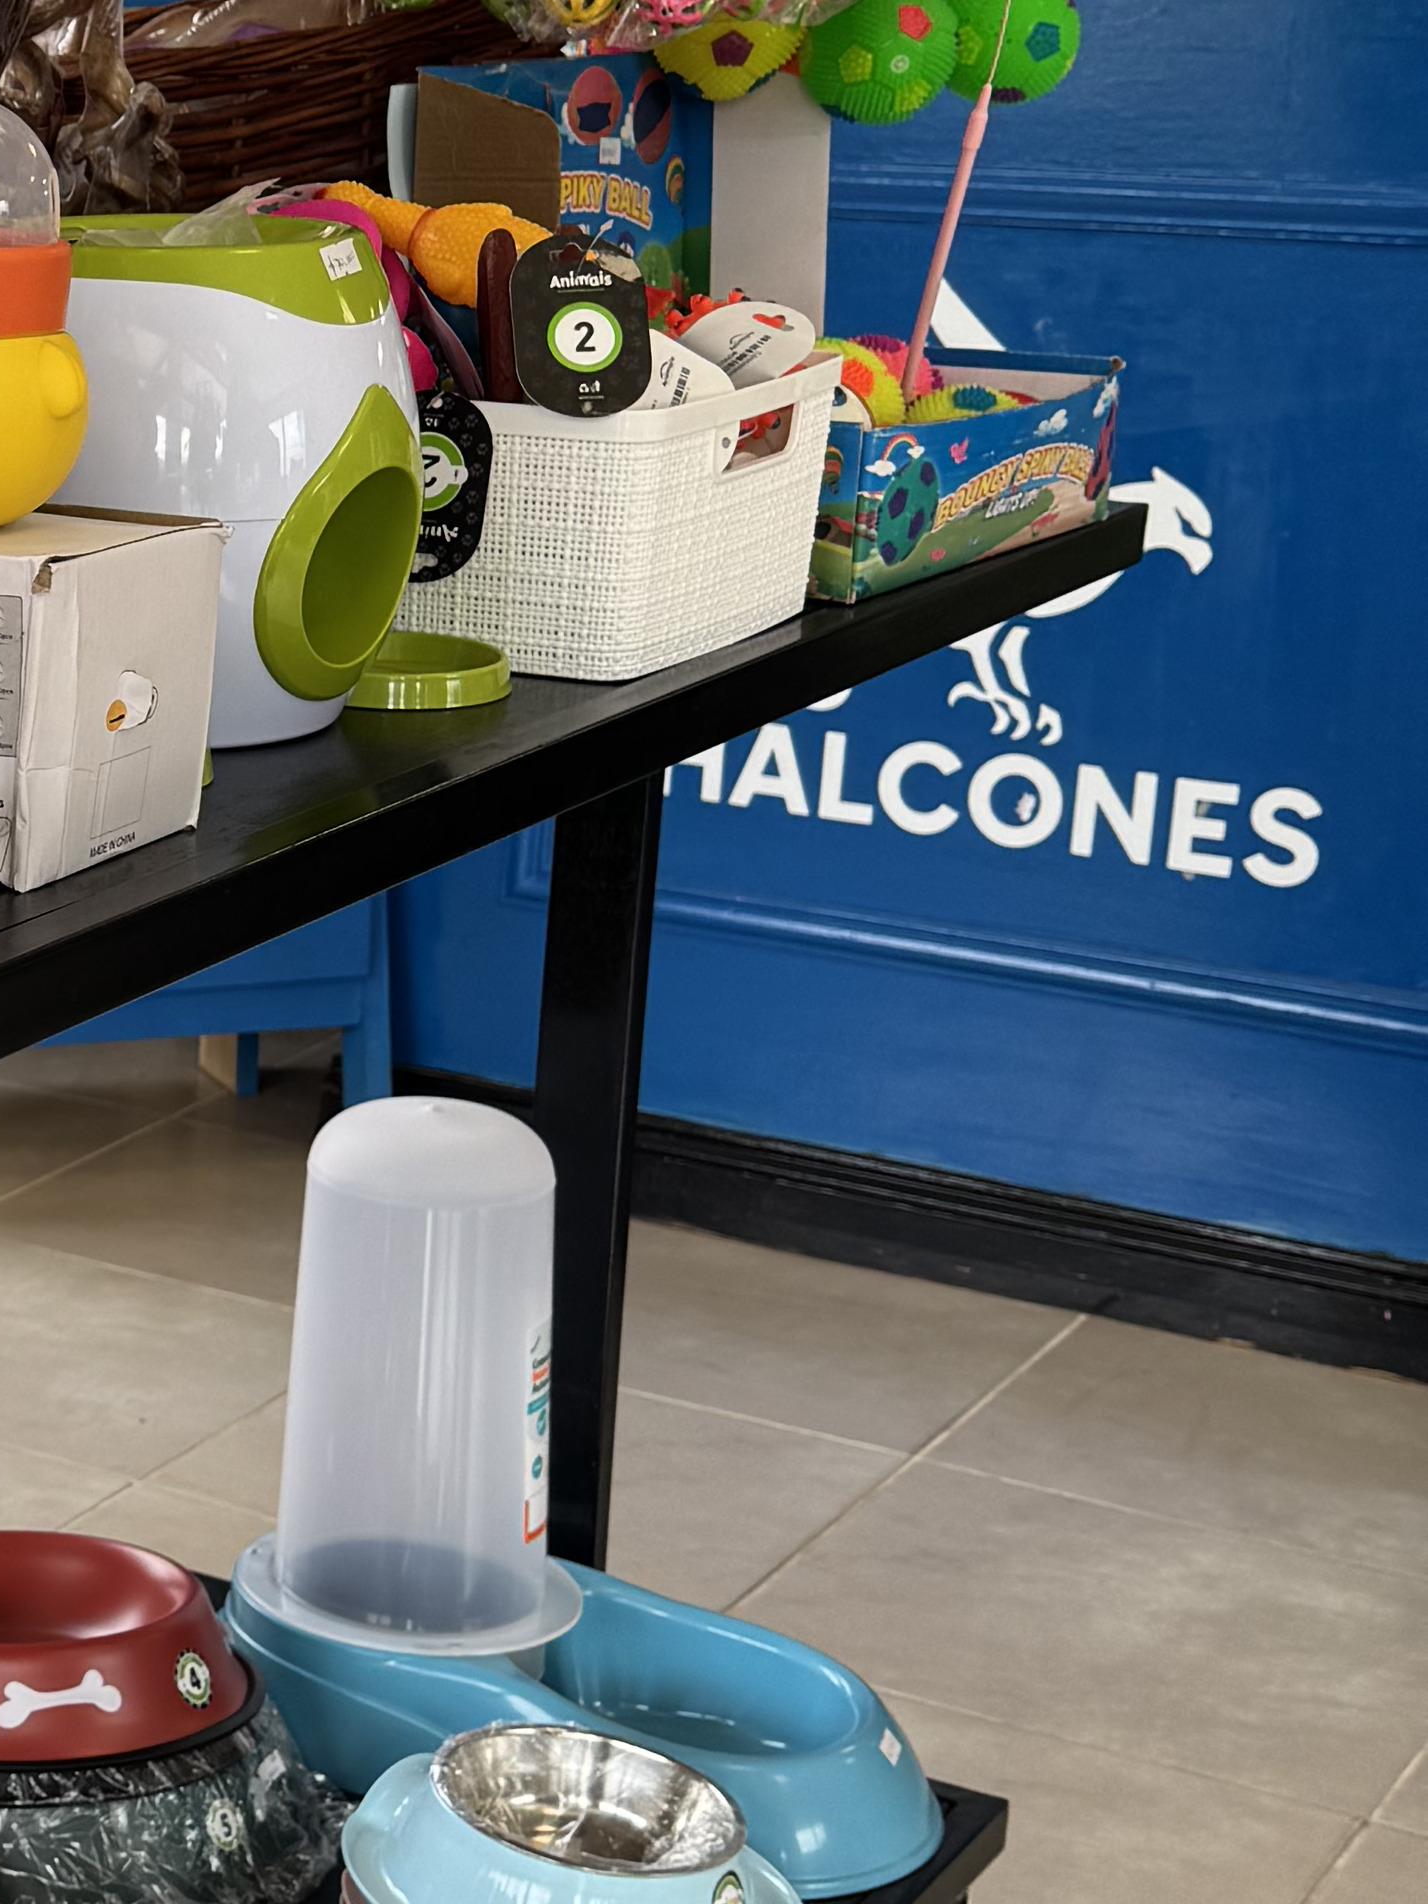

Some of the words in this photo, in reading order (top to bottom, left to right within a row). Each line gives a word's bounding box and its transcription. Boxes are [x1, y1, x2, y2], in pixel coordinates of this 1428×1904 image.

[560, 168, 607, 215] PIKY
[608, 172, 653, 232] BALL
[573, 321, 597, 353] 2
[932, 453, 1024, 533] BOUNCY
[663, 718, 1324, 889] HALCONES
[189, 1665, 202, 1691] 4
